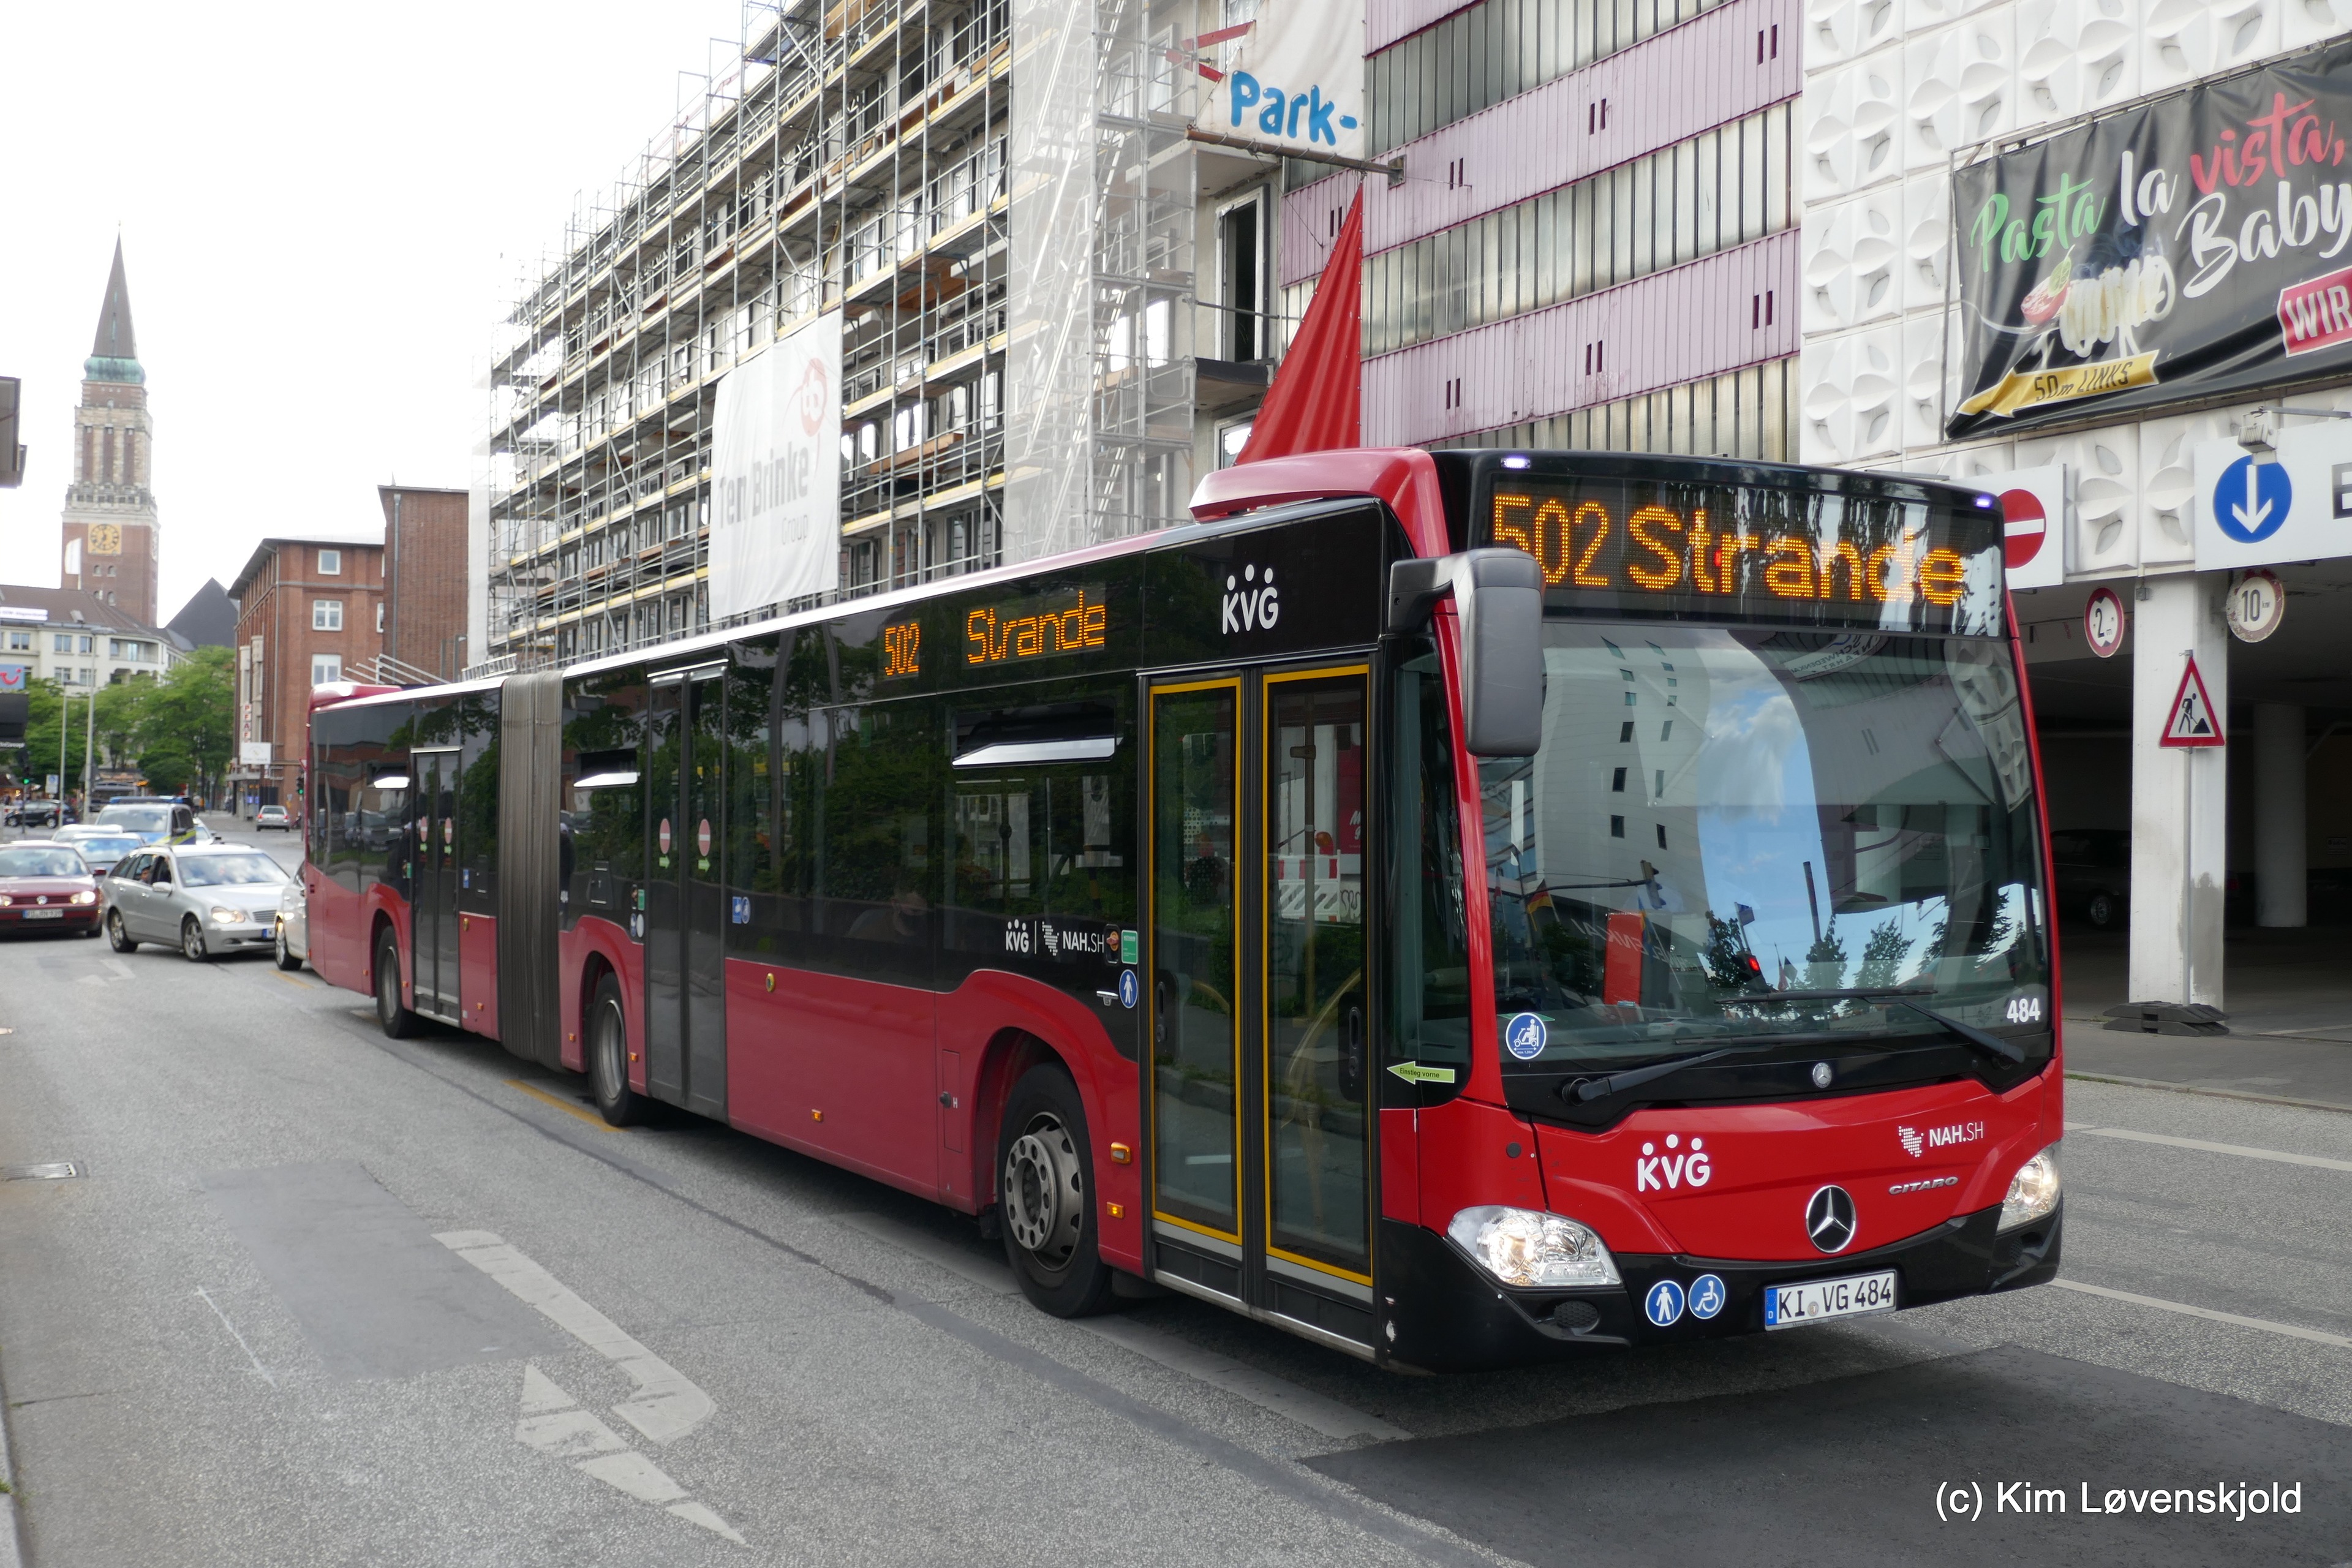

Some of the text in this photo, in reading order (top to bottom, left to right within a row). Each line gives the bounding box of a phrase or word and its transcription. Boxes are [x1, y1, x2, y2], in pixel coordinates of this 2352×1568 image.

[1231, 70, 1357, 146] Park-
[1970, 92, 2345, 273] Pasta la vista,
[2174, 181, 2352, 298] Baby
[2285, 285, 2352, 341] WIR
[2076, 361, 2133, 394] LINKS
[752, 441, 808, 518] Brinke
[782, 514, 808, 546] Group
[1493, 493, 1964, 606] 502 Strande
[1222, 586, 1278, 635] KVG
[2095, 608, 2105, 638] 2
[2241, 589, 2260, 622] 10
[884, 589, 1106, 676] 502 Strande
[1006, 930, 1029, 953] KVG
[1063, 931, 1104, 954] NAH.SH
[2007, 998, 2040, 1022] 484
[1400, 1068, 1421, 1077] Einstieg
[1929, 1121, 1983, 1148] NAH.SH
[1637, 1152, 1710, 1192] KVG
[1889, 1176, 1958, 1194] CITARO
[1779, 1278, 1891, 1319] KI VG 484
